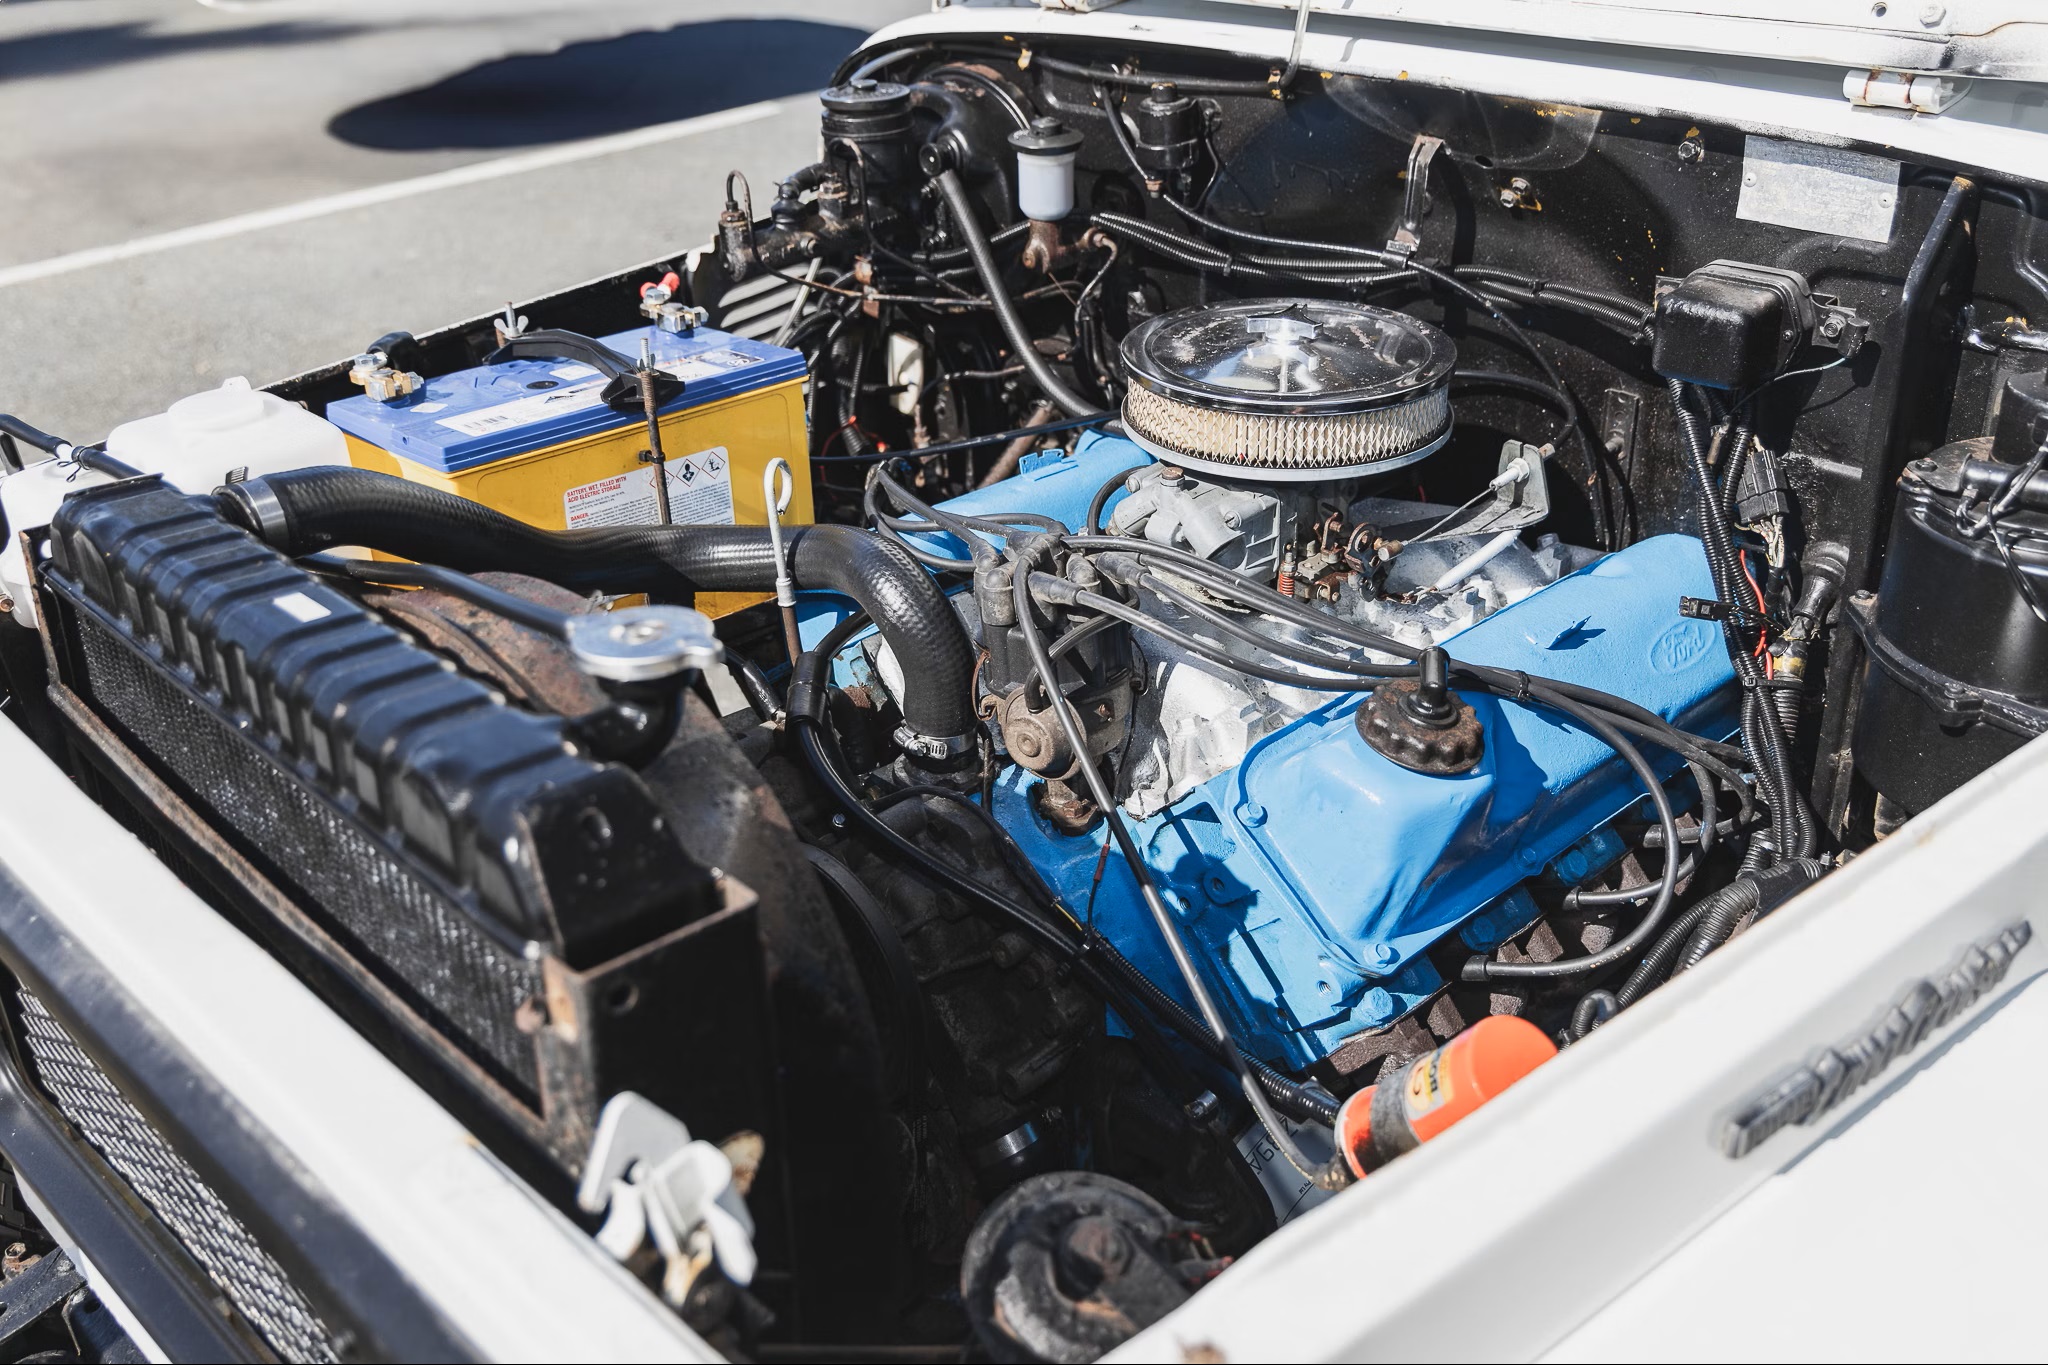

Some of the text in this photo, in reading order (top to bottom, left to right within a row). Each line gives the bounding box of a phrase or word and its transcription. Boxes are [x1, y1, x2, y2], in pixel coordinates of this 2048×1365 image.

[580, 489, 601, 500] ELECTRIC
[601, 483, 621, 493] STORAGE
[600, 479, 615, 488] FILLED
[1661, 625, 1706, 670] Ford
